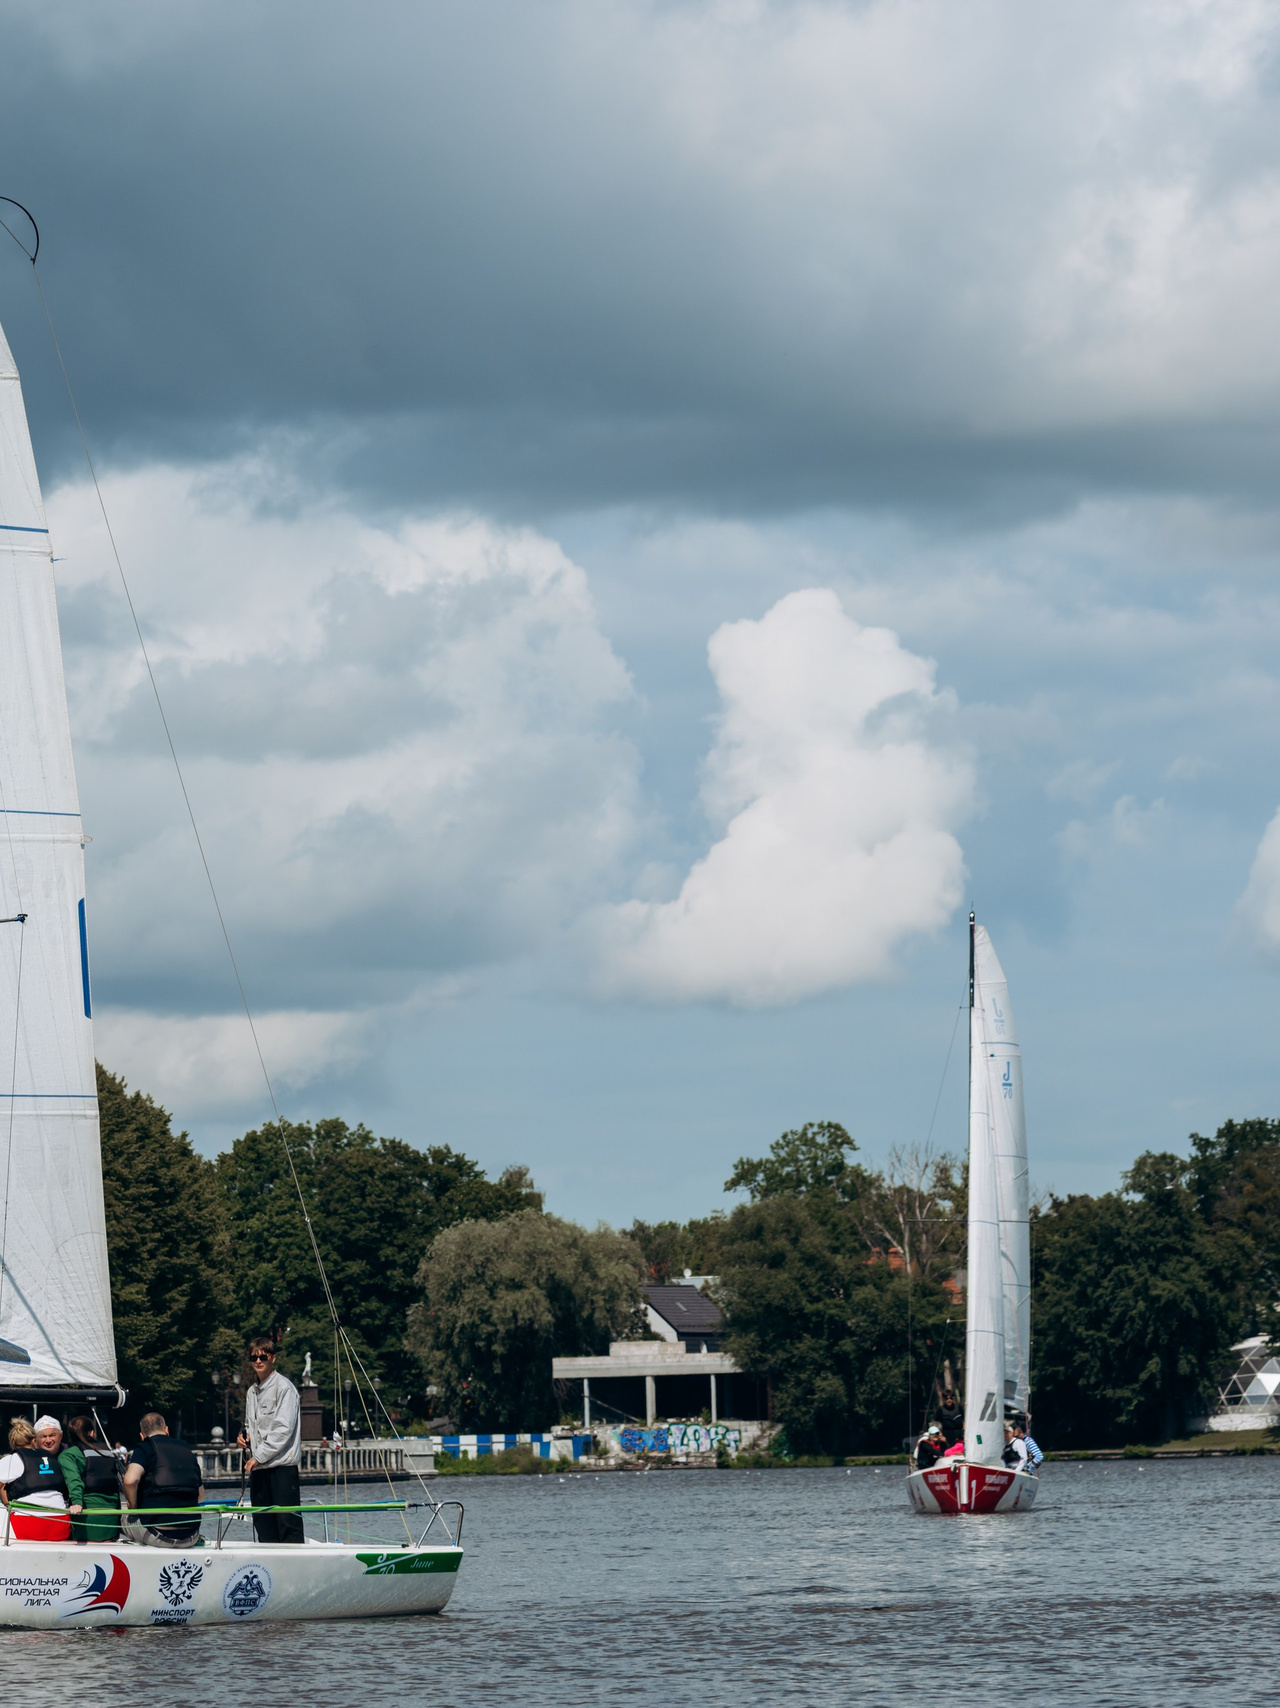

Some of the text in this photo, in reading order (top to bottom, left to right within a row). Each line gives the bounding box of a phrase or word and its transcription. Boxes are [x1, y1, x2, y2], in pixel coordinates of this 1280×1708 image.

[1002, 1061, 1010, 1081] J
[1003, 1087, 1013, 1099] 70
[5, 1588, 60, 1597] ПАРУСНАЯ
[24, 1598, 52, 1607] ЛИГА
[150, 1609, 196, 1617] МИНСПОРТ
